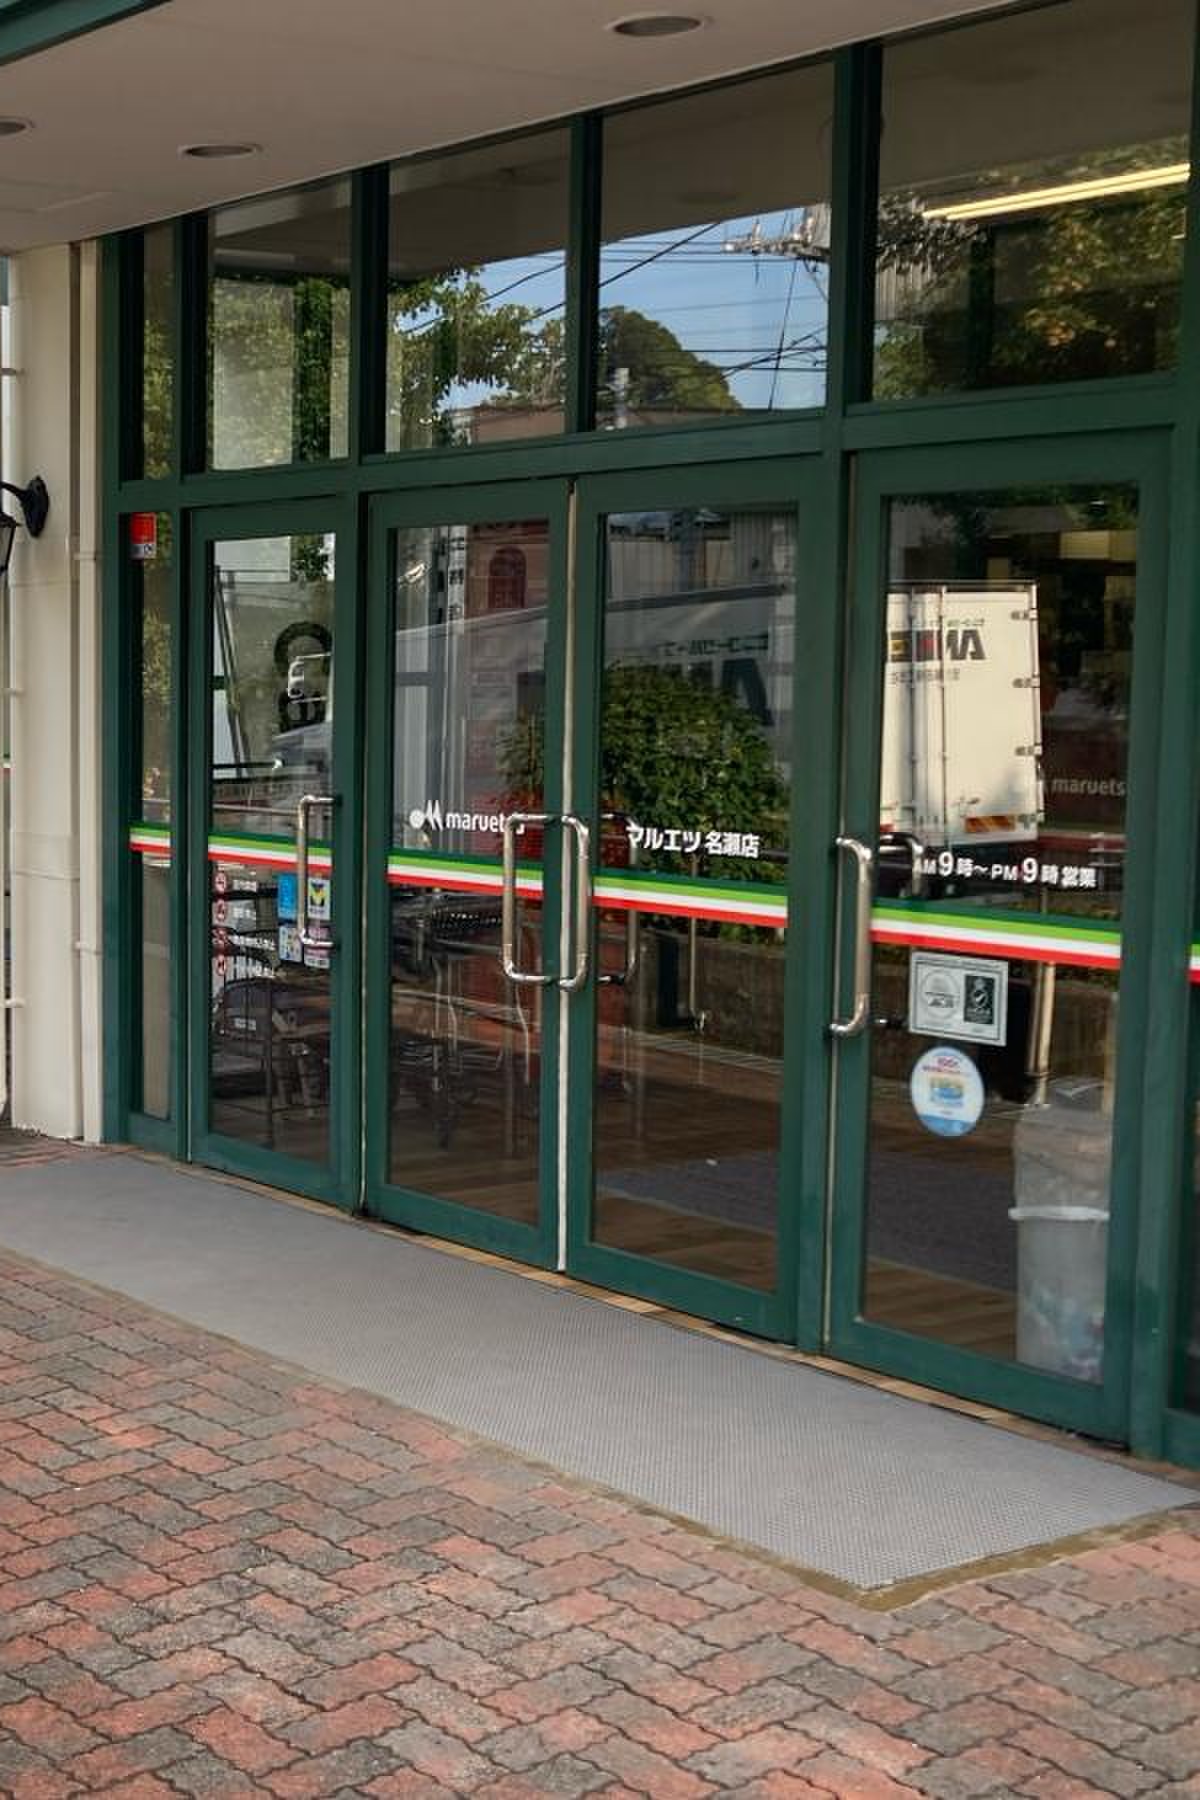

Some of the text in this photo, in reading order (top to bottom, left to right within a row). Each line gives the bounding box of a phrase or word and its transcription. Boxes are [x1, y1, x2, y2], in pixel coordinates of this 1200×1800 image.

[1052, 777, 1126, 797] maruets
[626, 825, 760, 858] マルエツ 名瀬店
